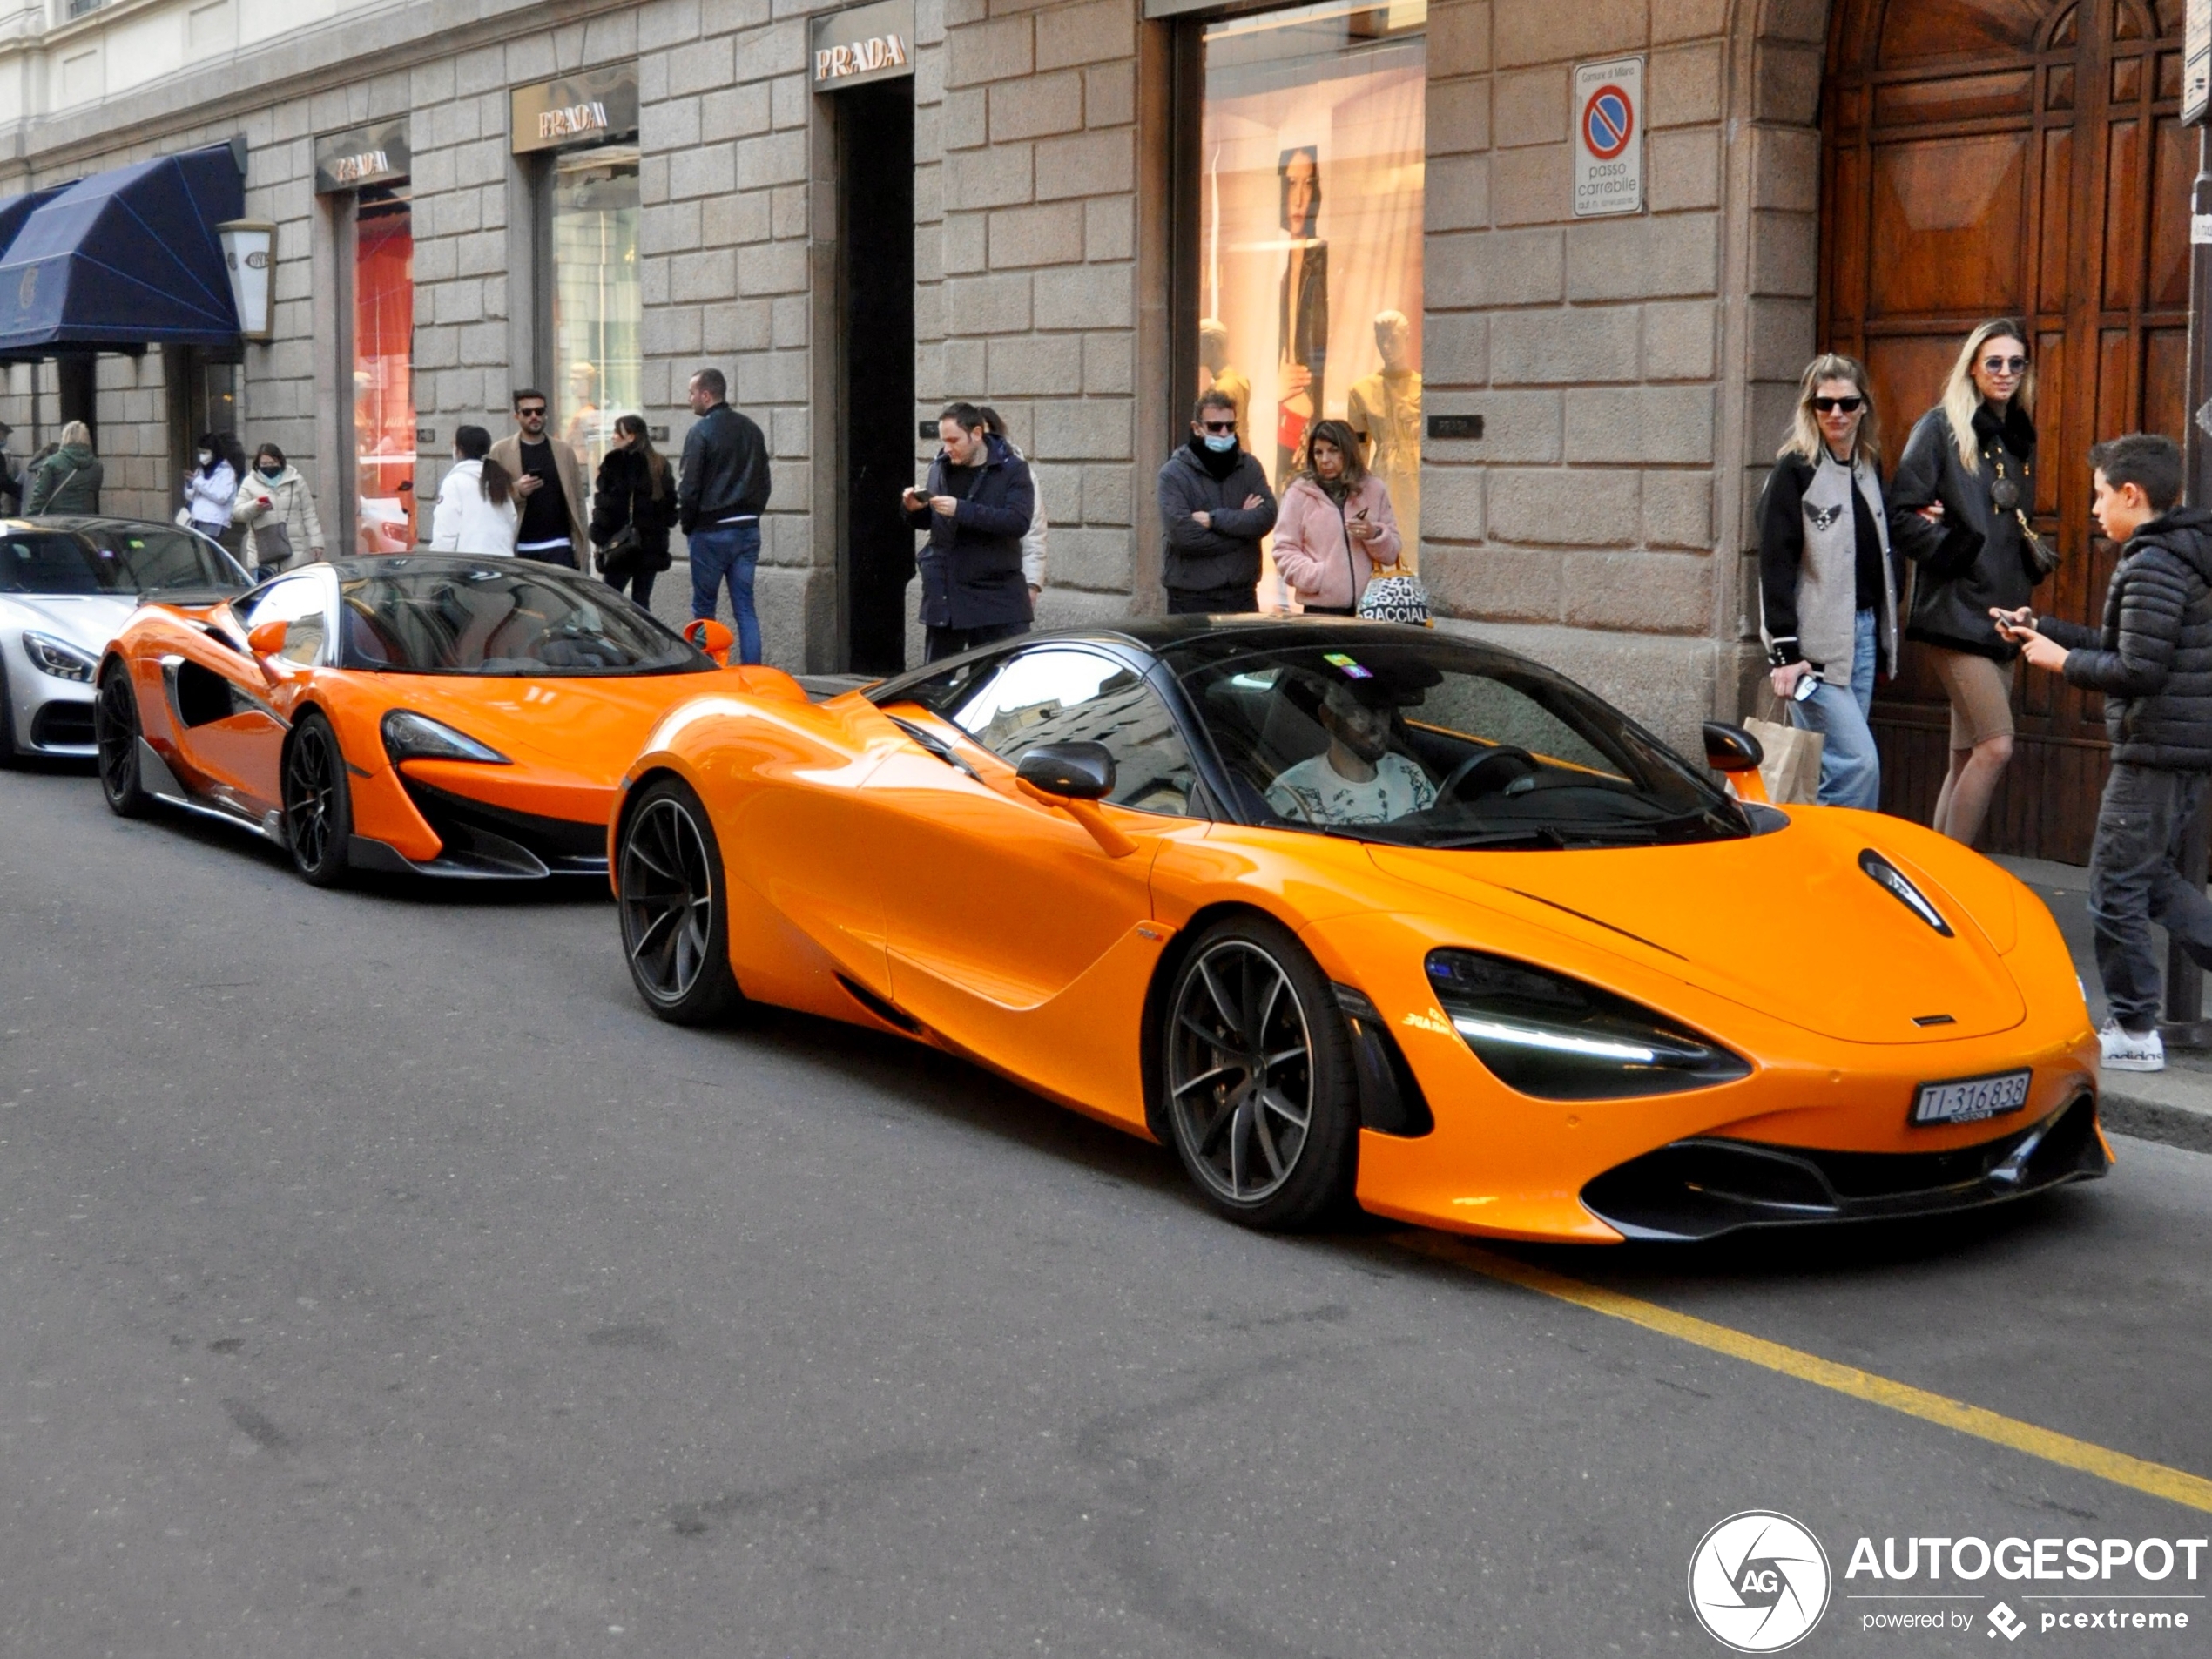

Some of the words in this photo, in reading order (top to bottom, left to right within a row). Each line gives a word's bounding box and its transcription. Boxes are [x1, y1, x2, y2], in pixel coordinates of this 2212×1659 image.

[815, 34, 907, 81] PRADA
[538, 102, 608, 138] PRADA
[1589, 163, 1627, 180] passo
